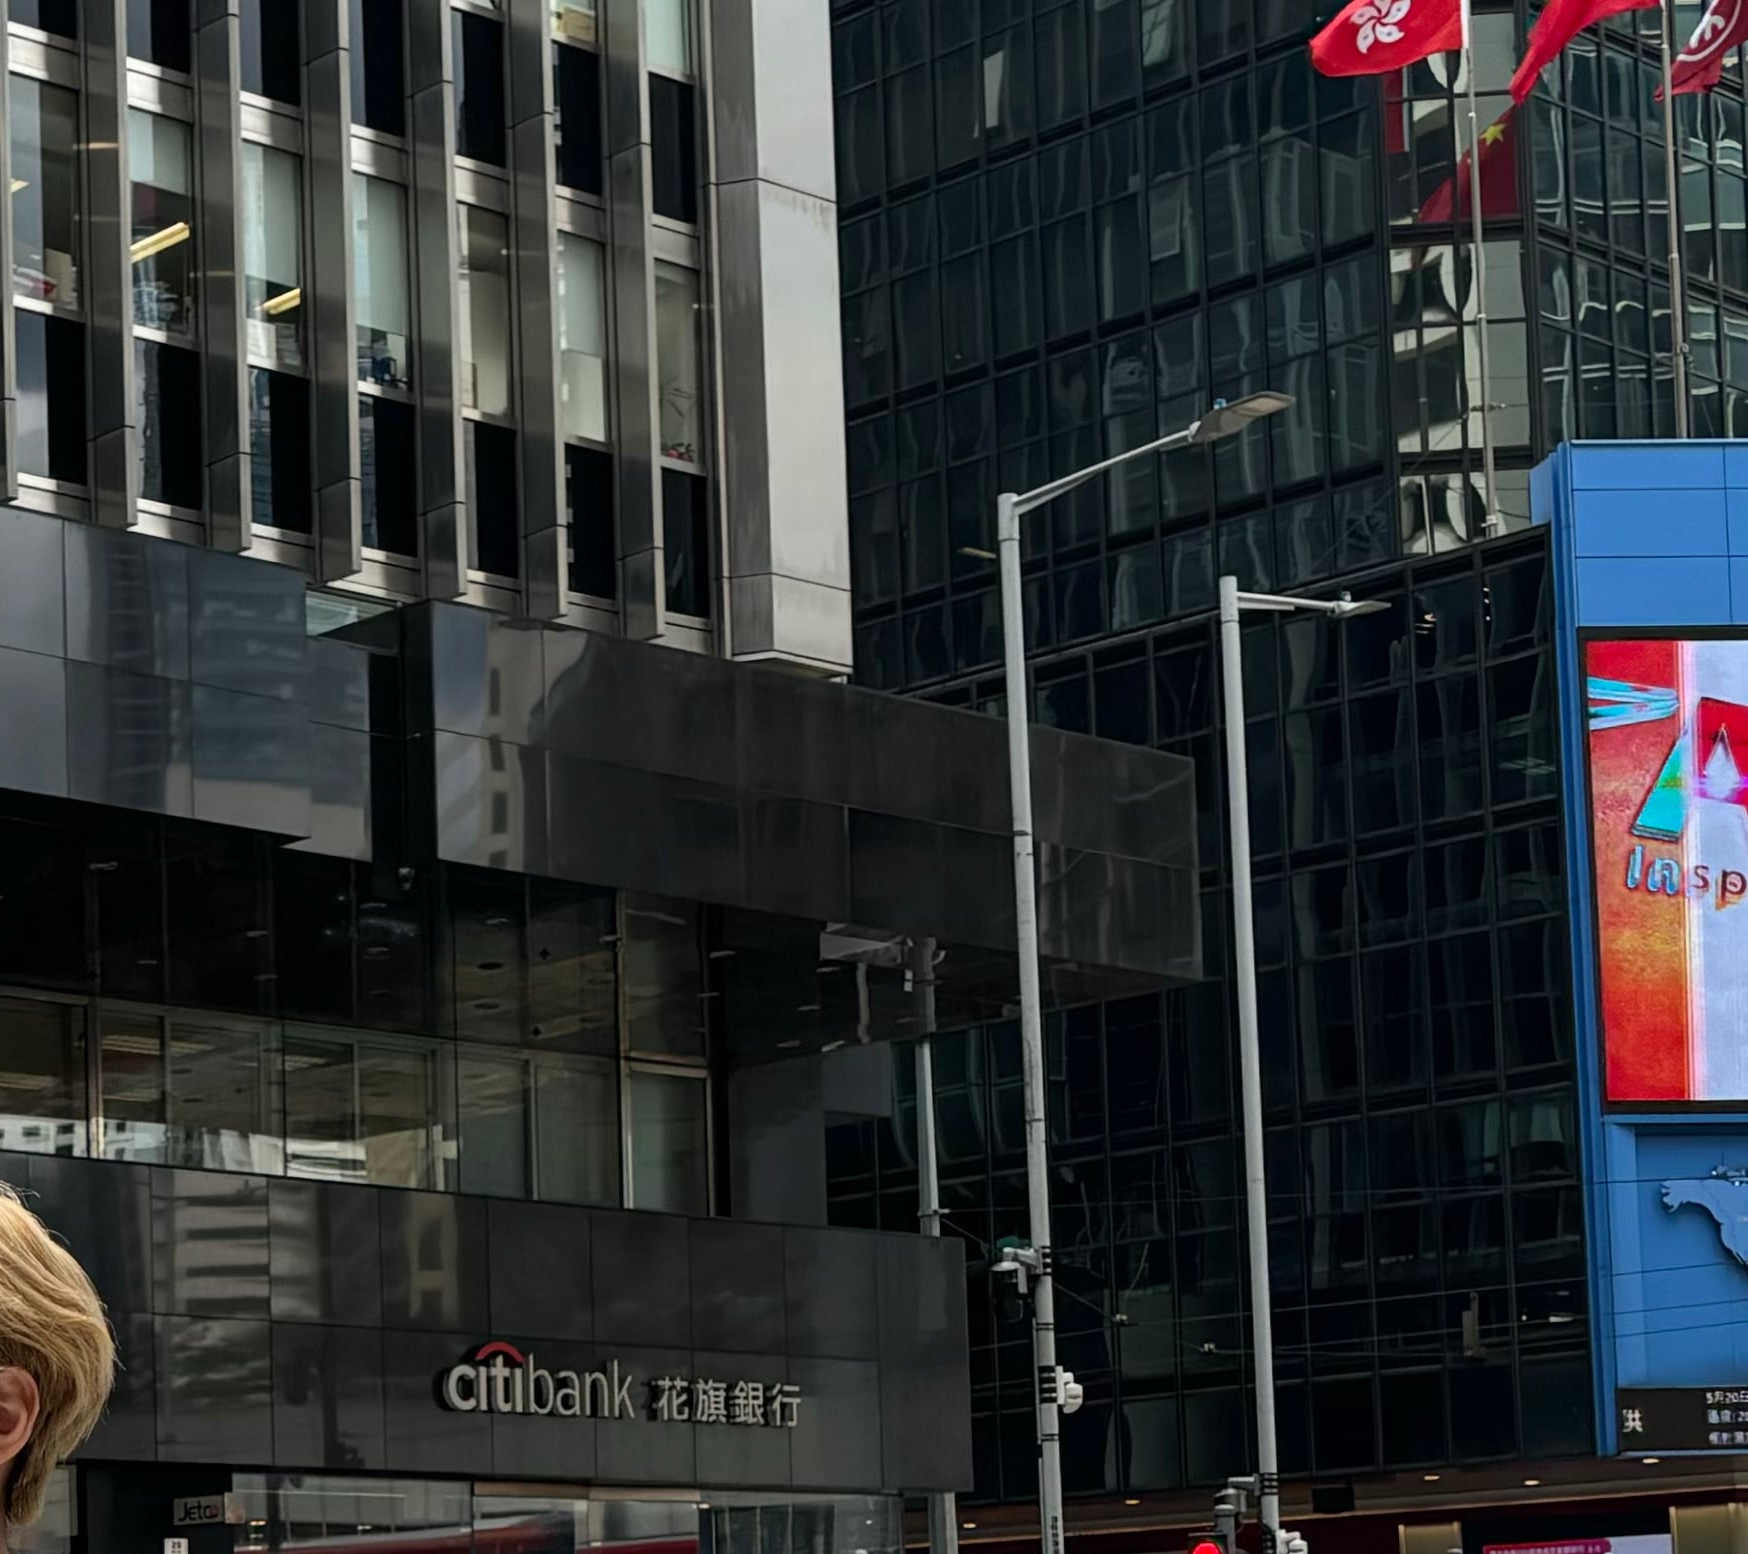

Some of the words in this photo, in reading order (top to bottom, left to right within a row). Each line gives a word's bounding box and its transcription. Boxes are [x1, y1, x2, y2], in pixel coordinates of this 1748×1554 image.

[449, 1350, 635, 1419] citibank
[652, 1375, 802, 1427] 花旗銀行
